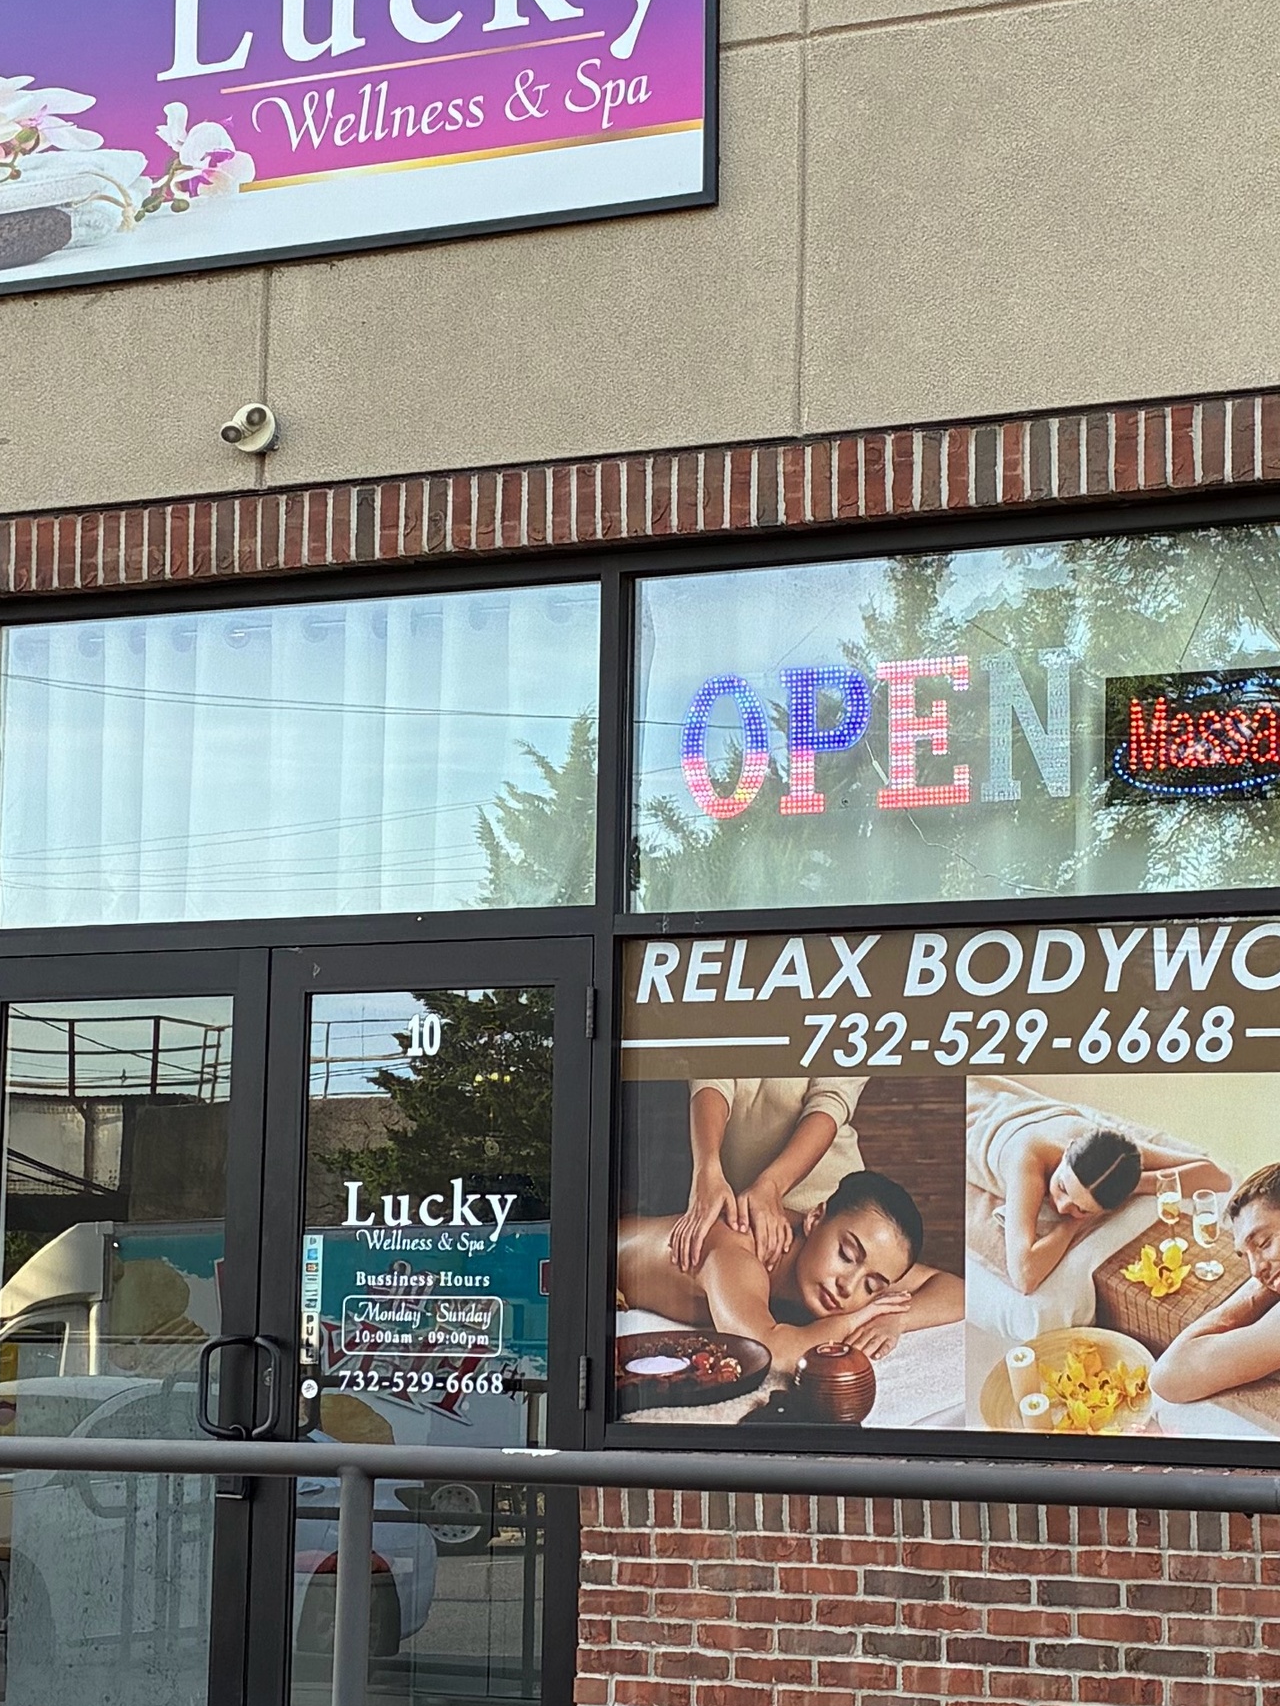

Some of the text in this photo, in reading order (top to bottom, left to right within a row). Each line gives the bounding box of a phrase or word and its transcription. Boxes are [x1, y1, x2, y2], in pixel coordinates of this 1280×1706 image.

[251, 56, 652, 153] Wellness & Spa
[679, 646, 1076, 820] OPEN
[635, 934, 883, 1005] RELAX
[407, 1013, 442, 1057] 10
[798, 1005, 1236, 1068] 732-529-6668
[341, 1177, 518, 1242] Lucky
[355, 1229, 486, 1258] Wellness & Spa
[355, 1270, 491, 1288] Bussiness Hours
[354, 1300, 421, 1329] Monday
[435, 1302, 493, 1330] Sunday
[354, 1329, 413, 1344] 10:00am
[338, 1369, 504, 1395] 732-529-6668
